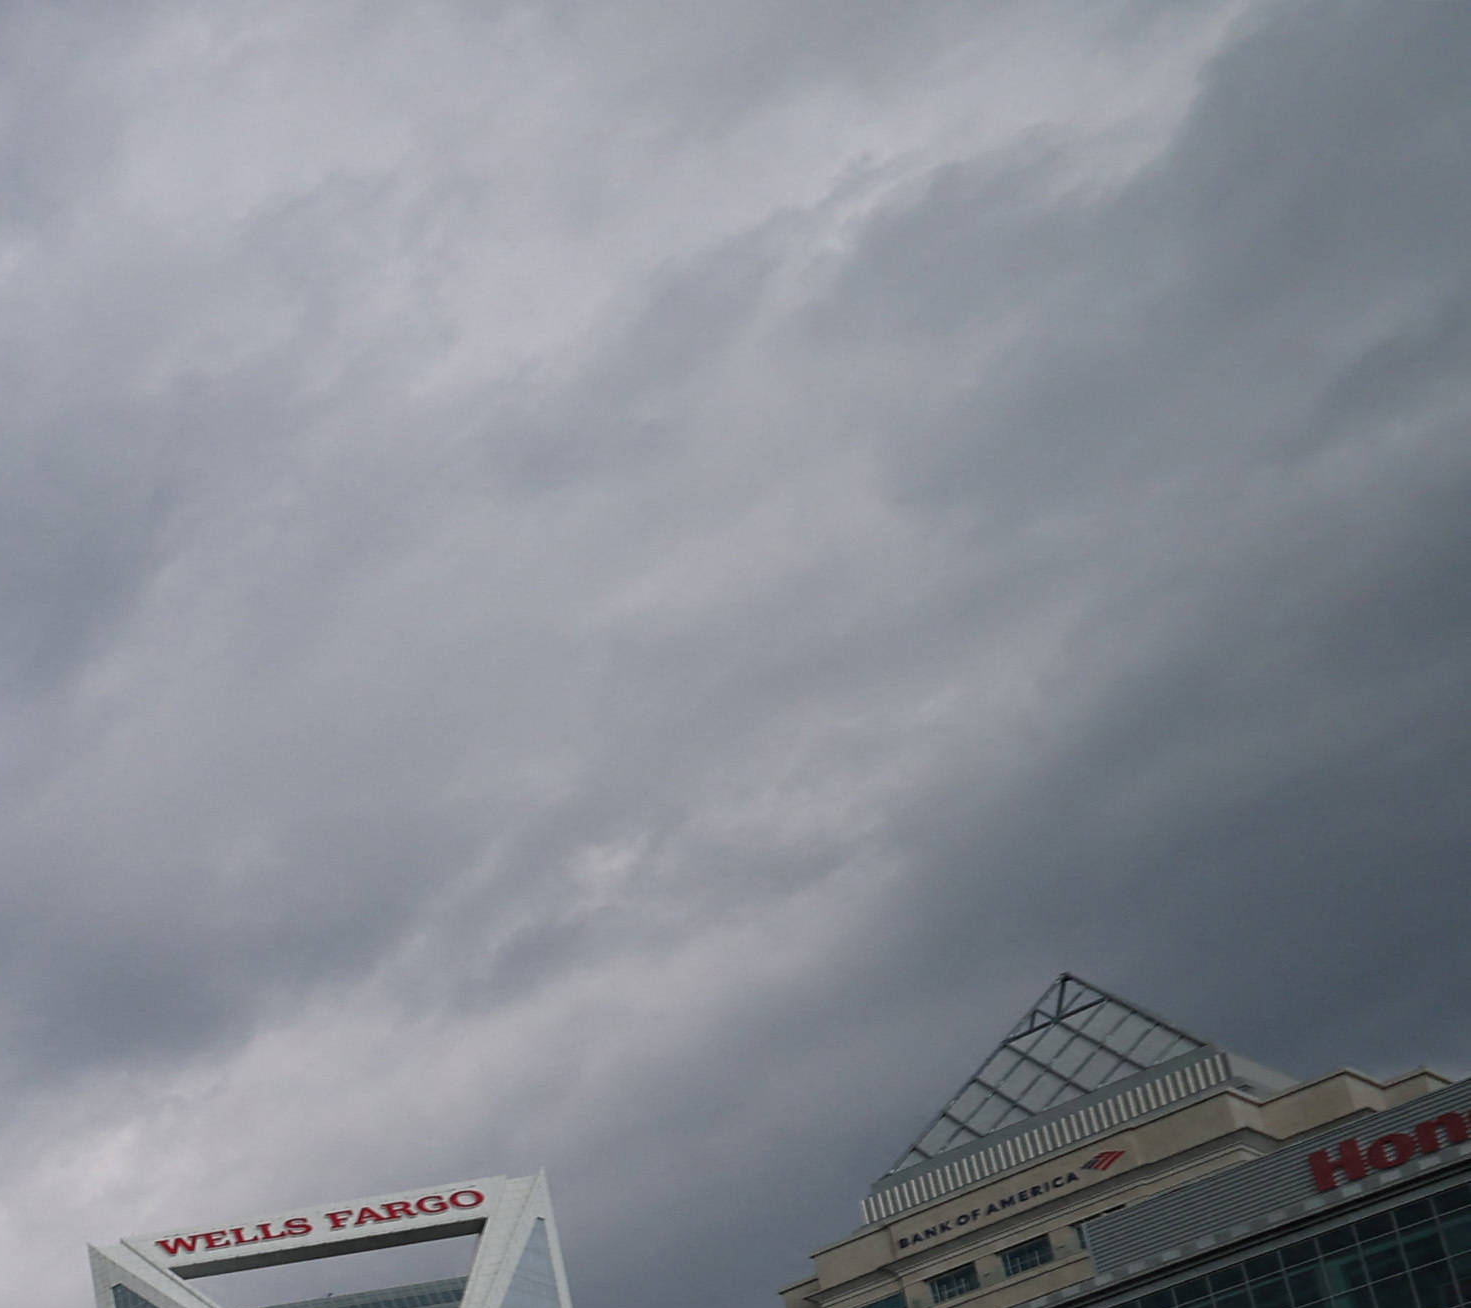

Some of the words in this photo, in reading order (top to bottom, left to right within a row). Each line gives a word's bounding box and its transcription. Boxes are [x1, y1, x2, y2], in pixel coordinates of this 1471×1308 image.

[155, 1217, 313, 1255] WELLS
[324, 1189, 485, 1230] FARGO
[899, 1220, 953, 1249] BANK
[956, 1206, 981, 1228] OF
[986, 1171, 1079, 1217] AMERICA
